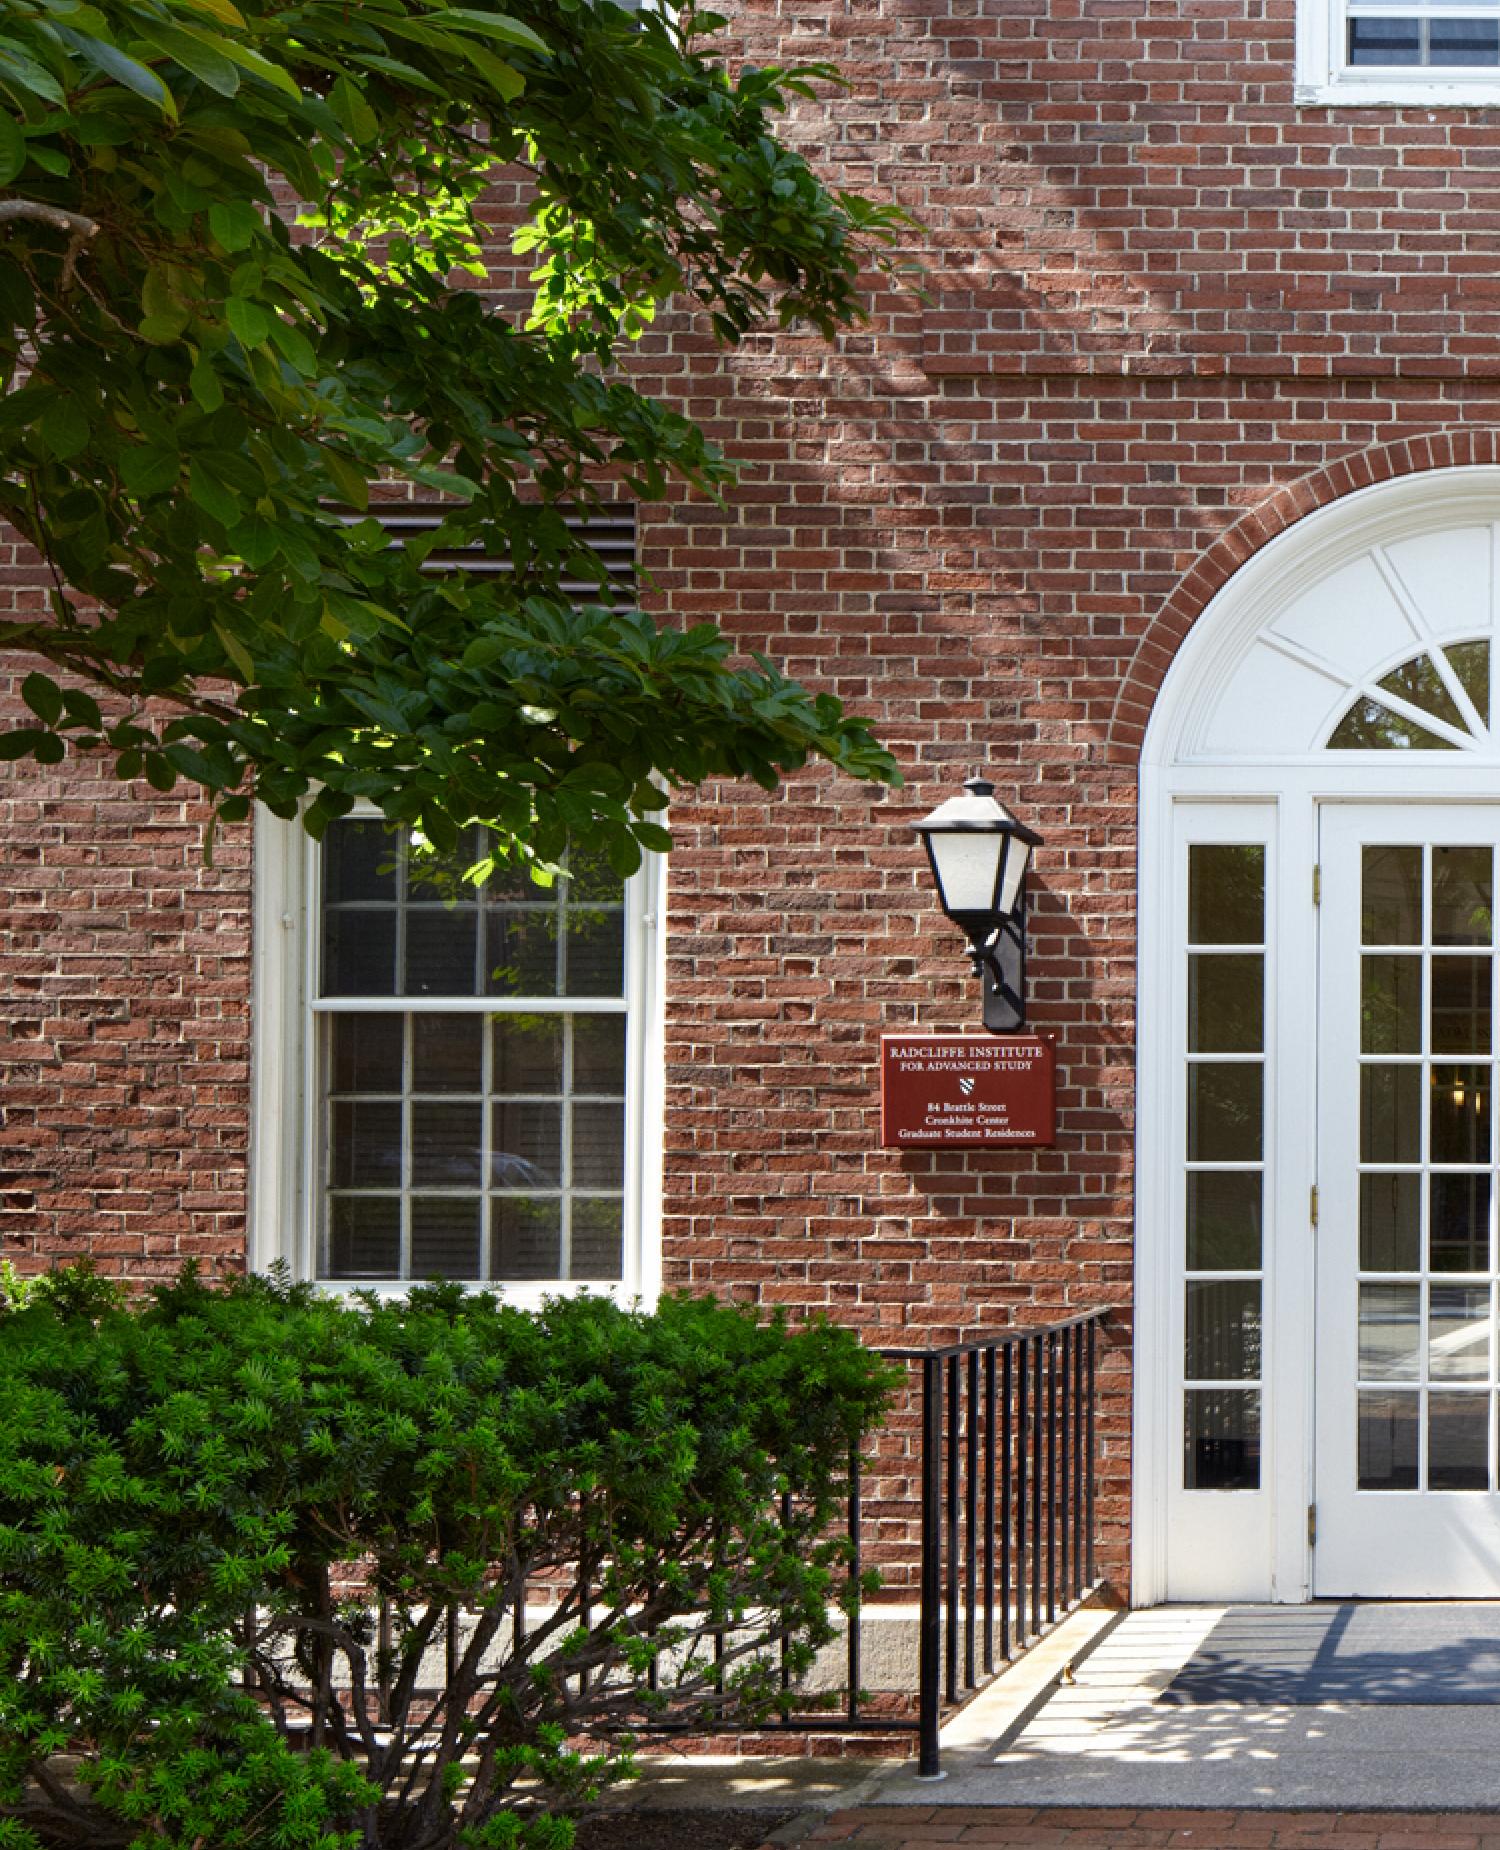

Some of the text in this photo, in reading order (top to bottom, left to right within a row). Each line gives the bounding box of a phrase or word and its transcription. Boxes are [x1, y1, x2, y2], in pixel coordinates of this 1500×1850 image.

[889, 1046, 1043, 1058] RADCLIFFE INSTITUTE
[899, 1061, 1033, 1072] FOR ADVANCED STUDY
[943, 1103, 975, 1112] Brattle
[977, 1103, 1007, 1112] Street
[975, 1115, 1009, 1126] Center
[898, 1128, 942, 1138] Graduate
[944, 1128, 981, 1138] Student
